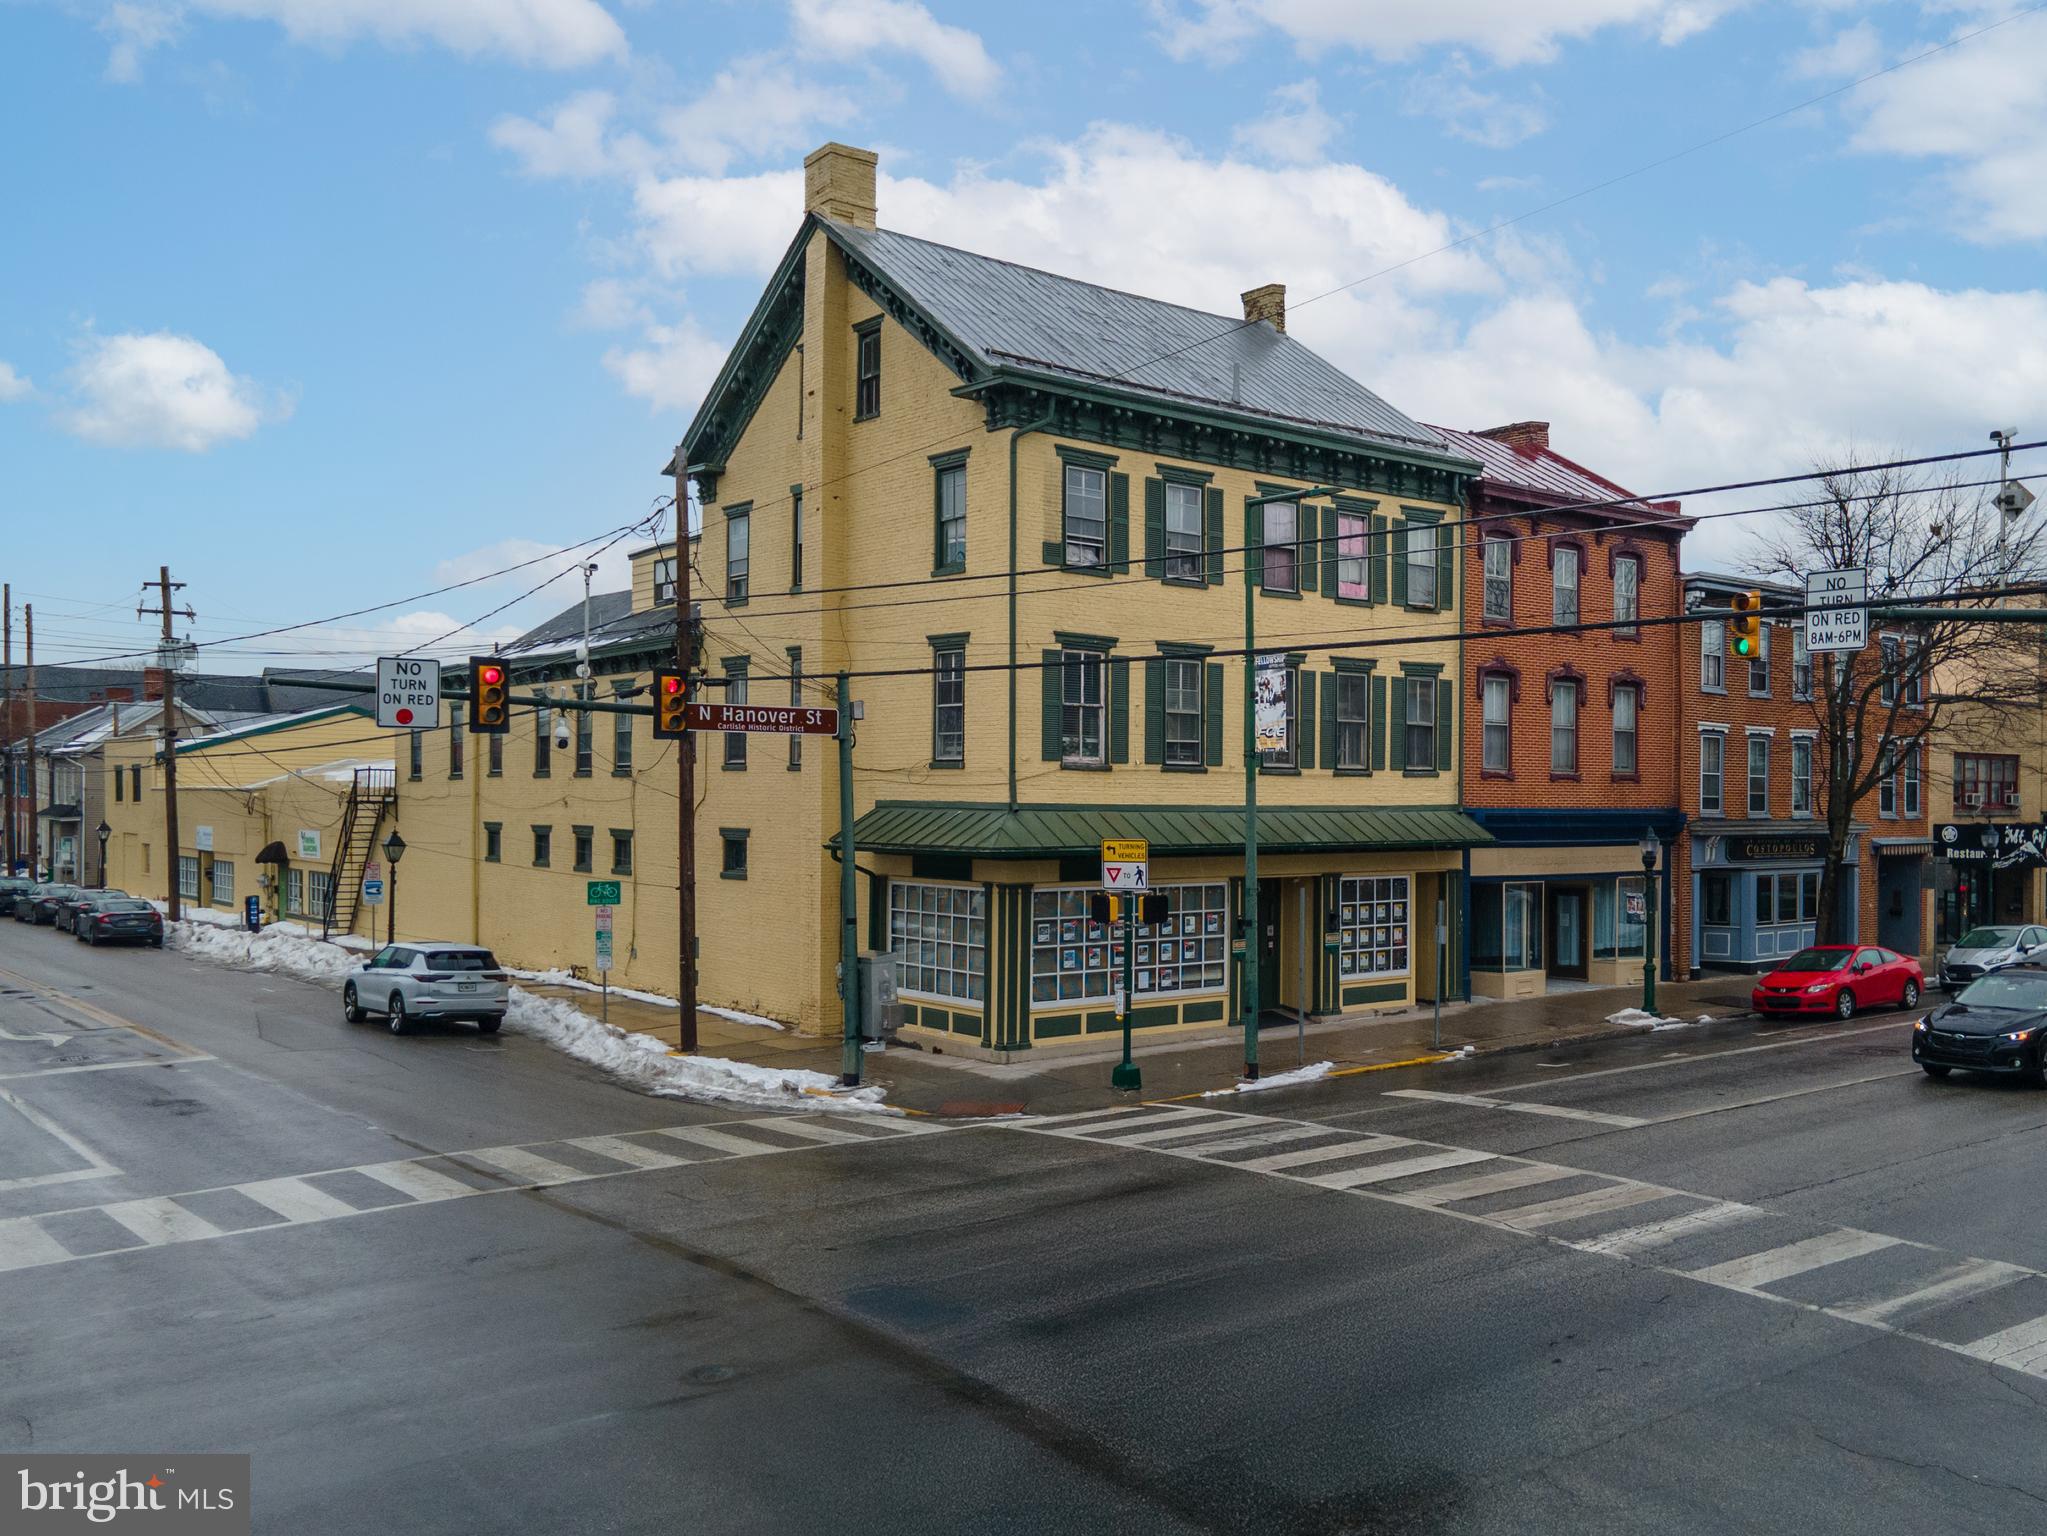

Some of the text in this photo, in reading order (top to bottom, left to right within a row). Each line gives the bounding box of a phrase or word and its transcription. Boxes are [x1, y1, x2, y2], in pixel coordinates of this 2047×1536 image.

[1826, 577, 1847, 590] NO
[1819, 594, 1853, 606] TURN
[1812, 611, 1860, 627] ON RED
[1810, 629, 1862, 645] 8AM-6PM
[396, 662, 422, 676] NO
[390, 678, 427, 691] TURN
[383, 693, 434, 706] ON RED
[699, 706, 822, 725] N Hanover St
[717, 722, 805, 733] Carlisle Historic District
[1946, 847, 1999, 859] Restaurt
